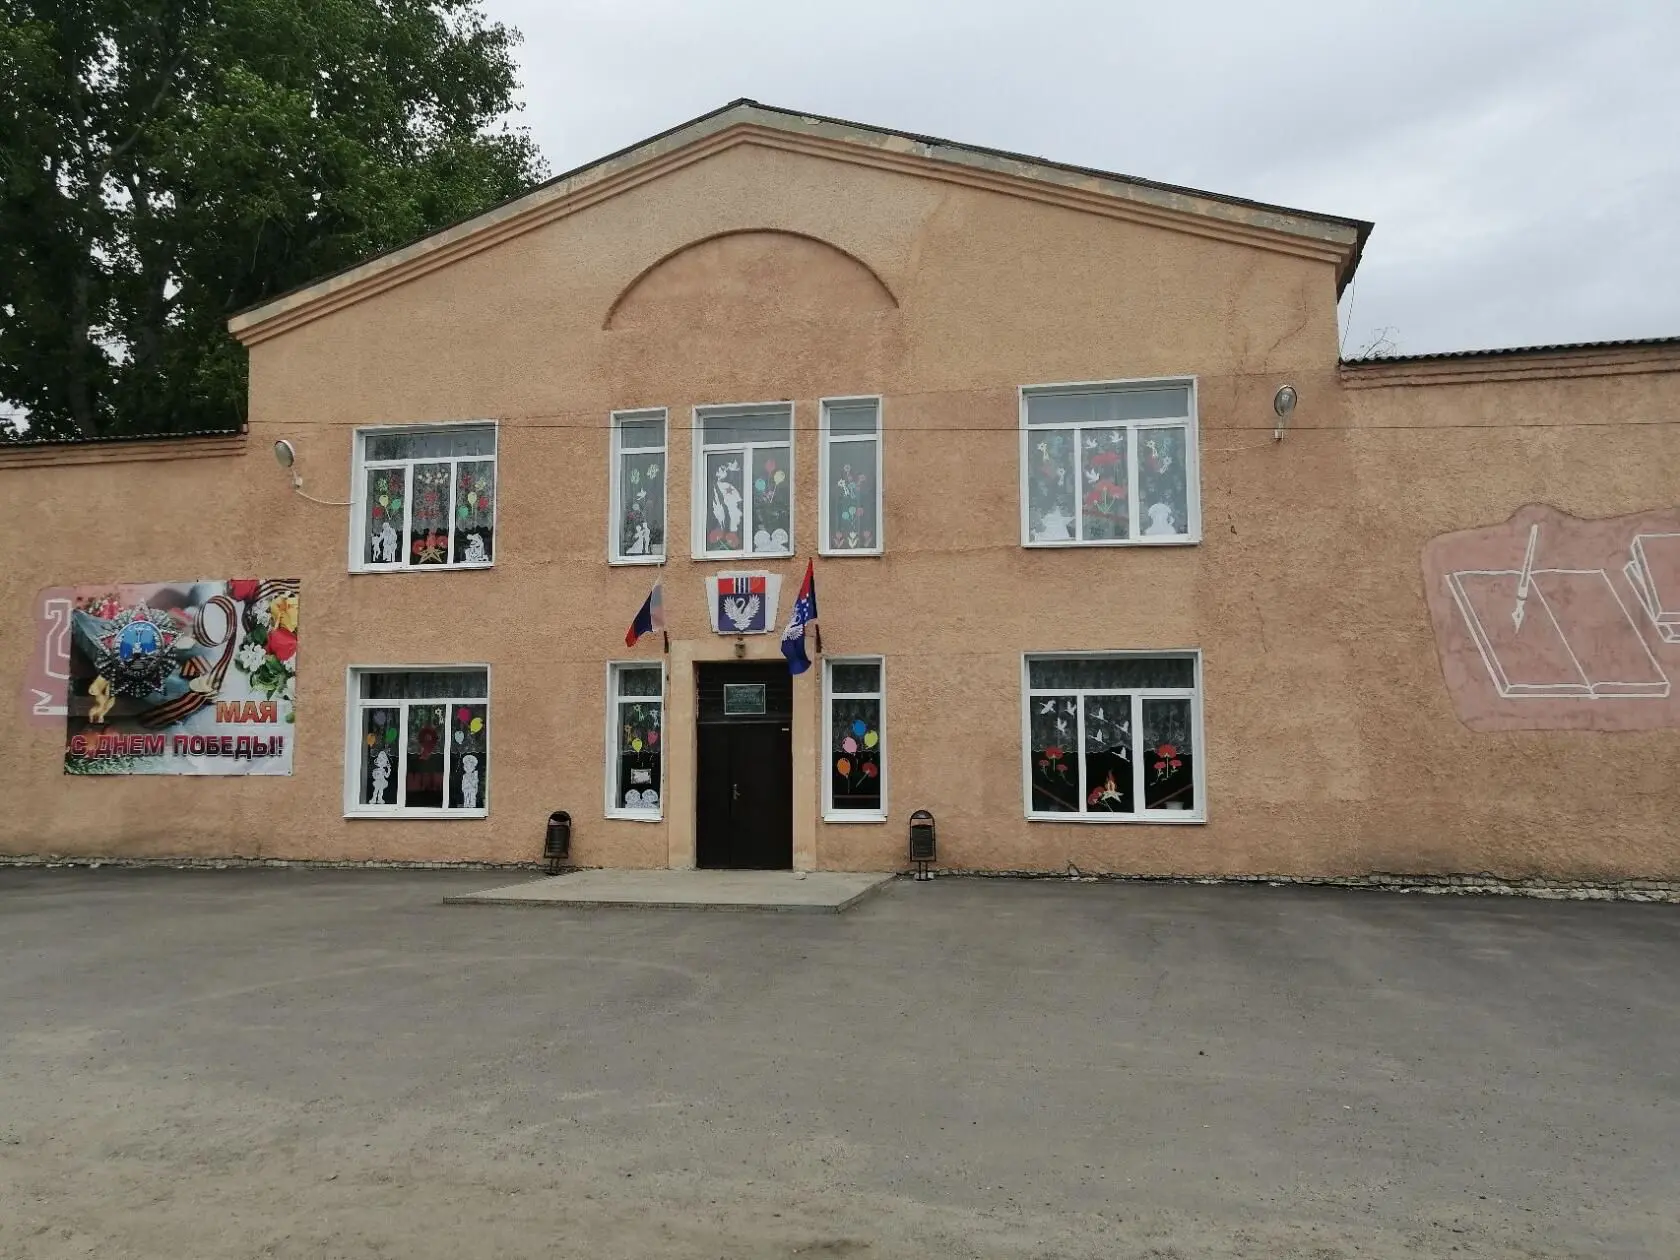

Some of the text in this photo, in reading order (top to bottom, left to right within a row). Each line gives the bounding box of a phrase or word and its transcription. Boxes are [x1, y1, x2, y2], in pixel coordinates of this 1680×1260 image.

[217, 701, 277, 723] МАЯ
[71, 735, 284, 761] С ДНЕМ ПОБЕДЫ!
